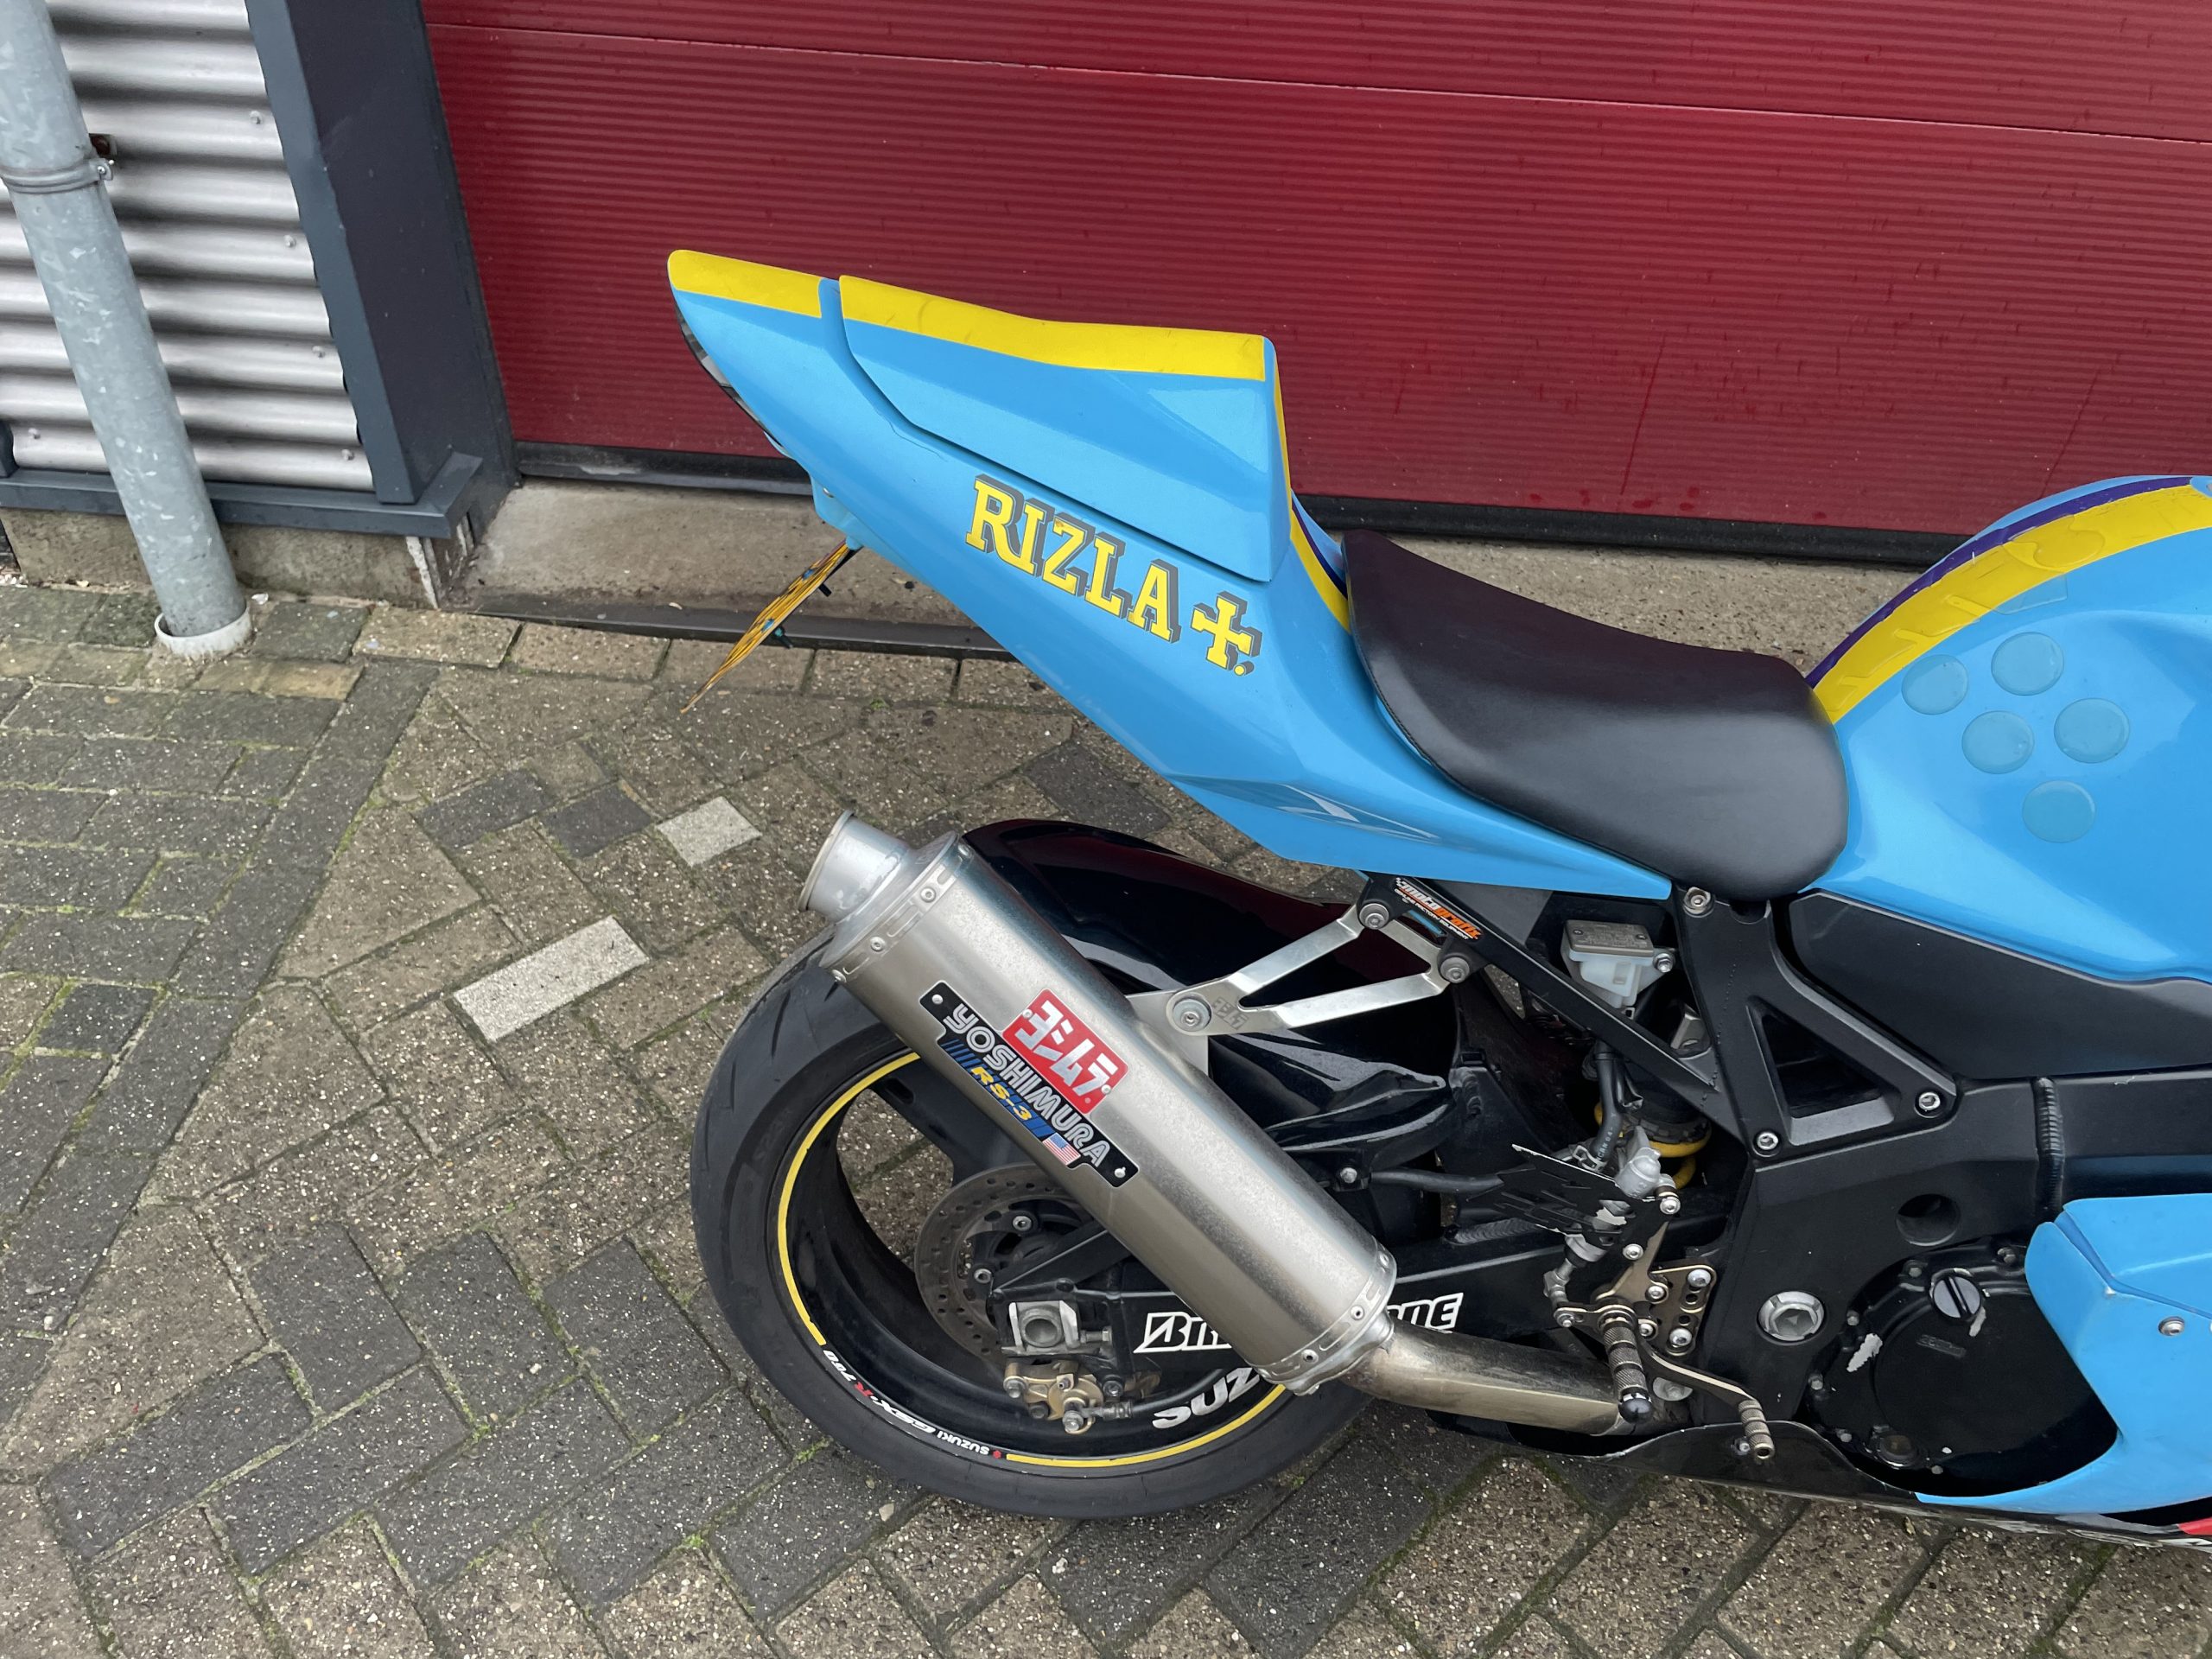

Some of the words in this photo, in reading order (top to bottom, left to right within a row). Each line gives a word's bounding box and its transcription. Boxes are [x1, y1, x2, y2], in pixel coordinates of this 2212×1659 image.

[943, 1003, 1110, 1166] YOSHIMURA
[1014, 1000, 1119, 1096] ヨシムラ
[969, 1066, 1033, 1121] RS-3
[937, 1431, 990, 1455] SUZUKI
